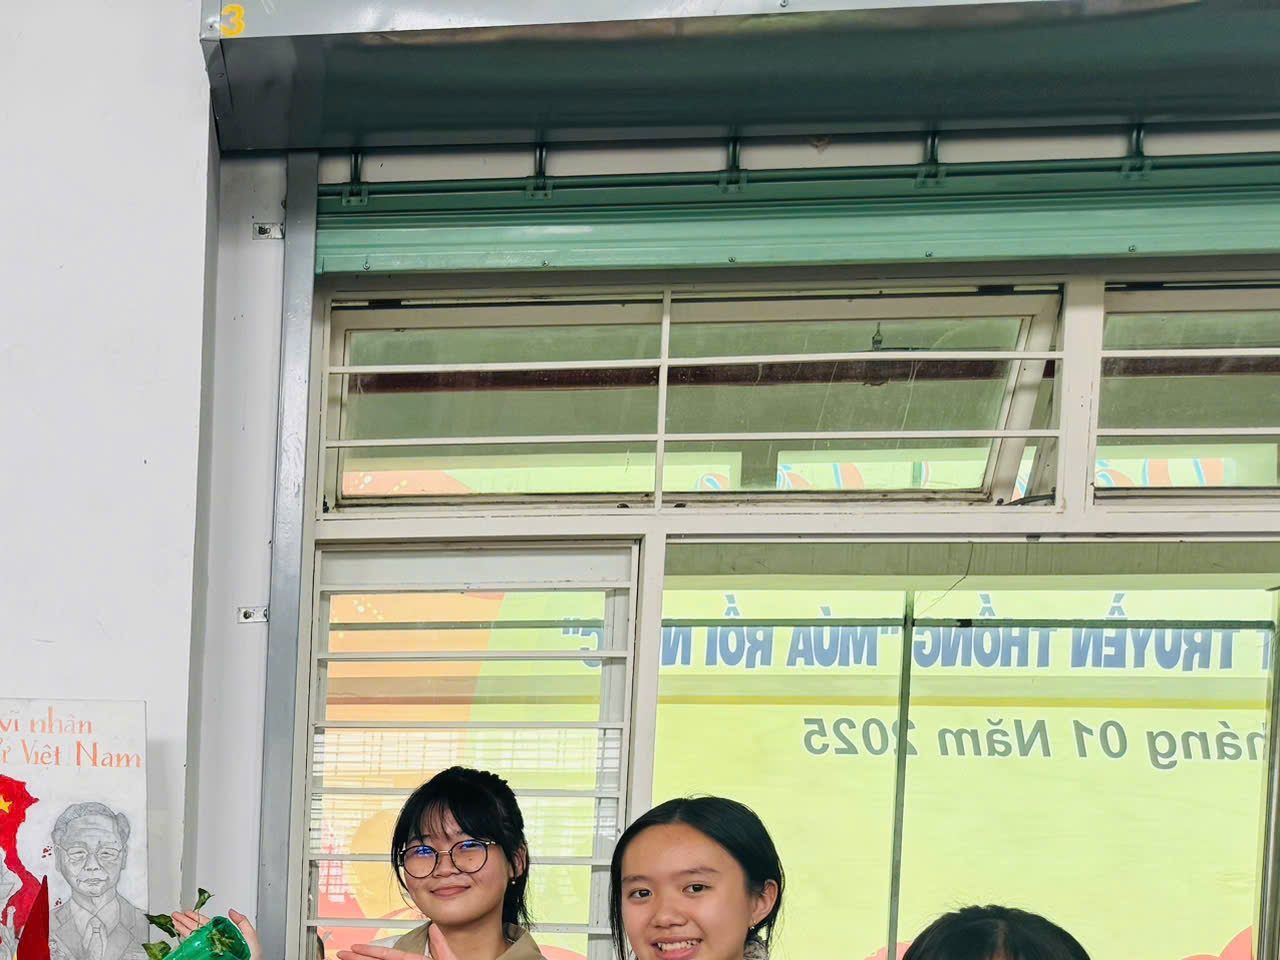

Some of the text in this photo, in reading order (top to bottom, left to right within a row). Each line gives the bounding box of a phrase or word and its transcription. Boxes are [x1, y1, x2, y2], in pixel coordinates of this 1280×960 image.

[221, 4, 245, 37] 3
[29, 706, 93, 735] nhân
[20, 738, 61, 769] Việt
[75, 740, 142, 769] Nam
